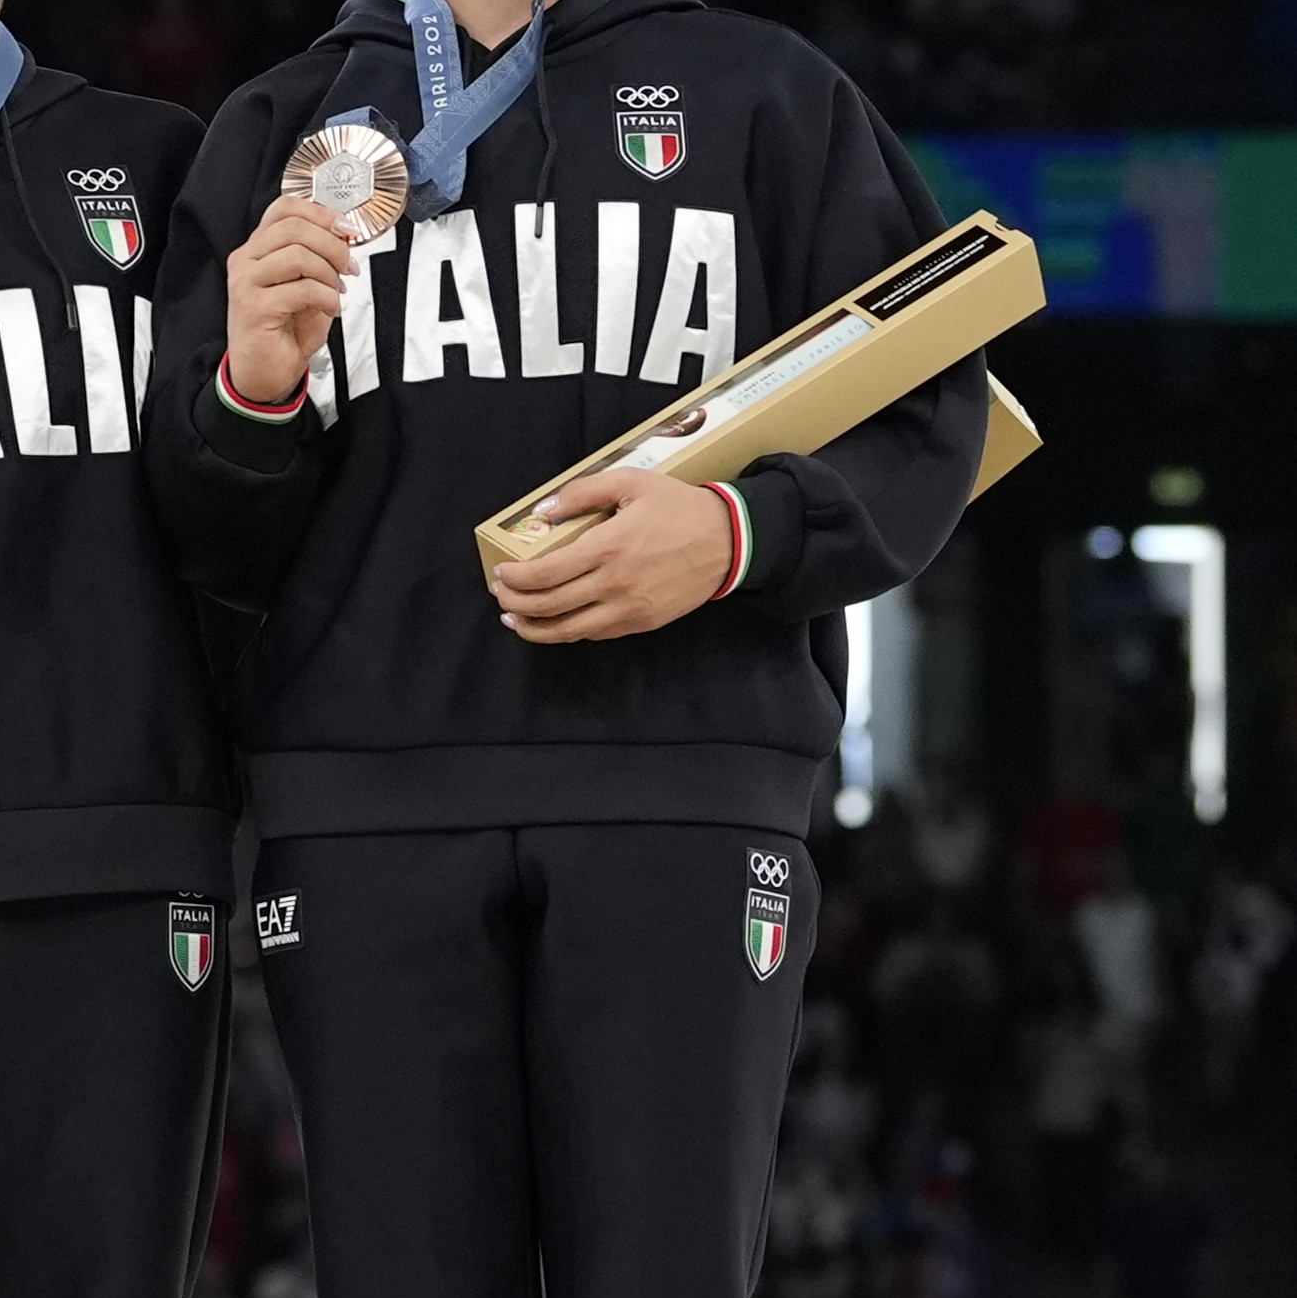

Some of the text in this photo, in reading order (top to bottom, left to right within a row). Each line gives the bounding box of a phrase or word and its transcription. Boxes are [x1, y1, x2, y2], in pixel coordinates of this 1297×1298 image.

[422, 15, 442, 55] 202
[623, 116, 677, 126] ITALIA
[82, 201, 131, 211] ITALIA
[309, 201, 737, 433] TALIA
[751, 895, 784, 913] ITALIA
[173, 909, 210, 922] ITALIA
[257, 895, 297, 937] EA7
